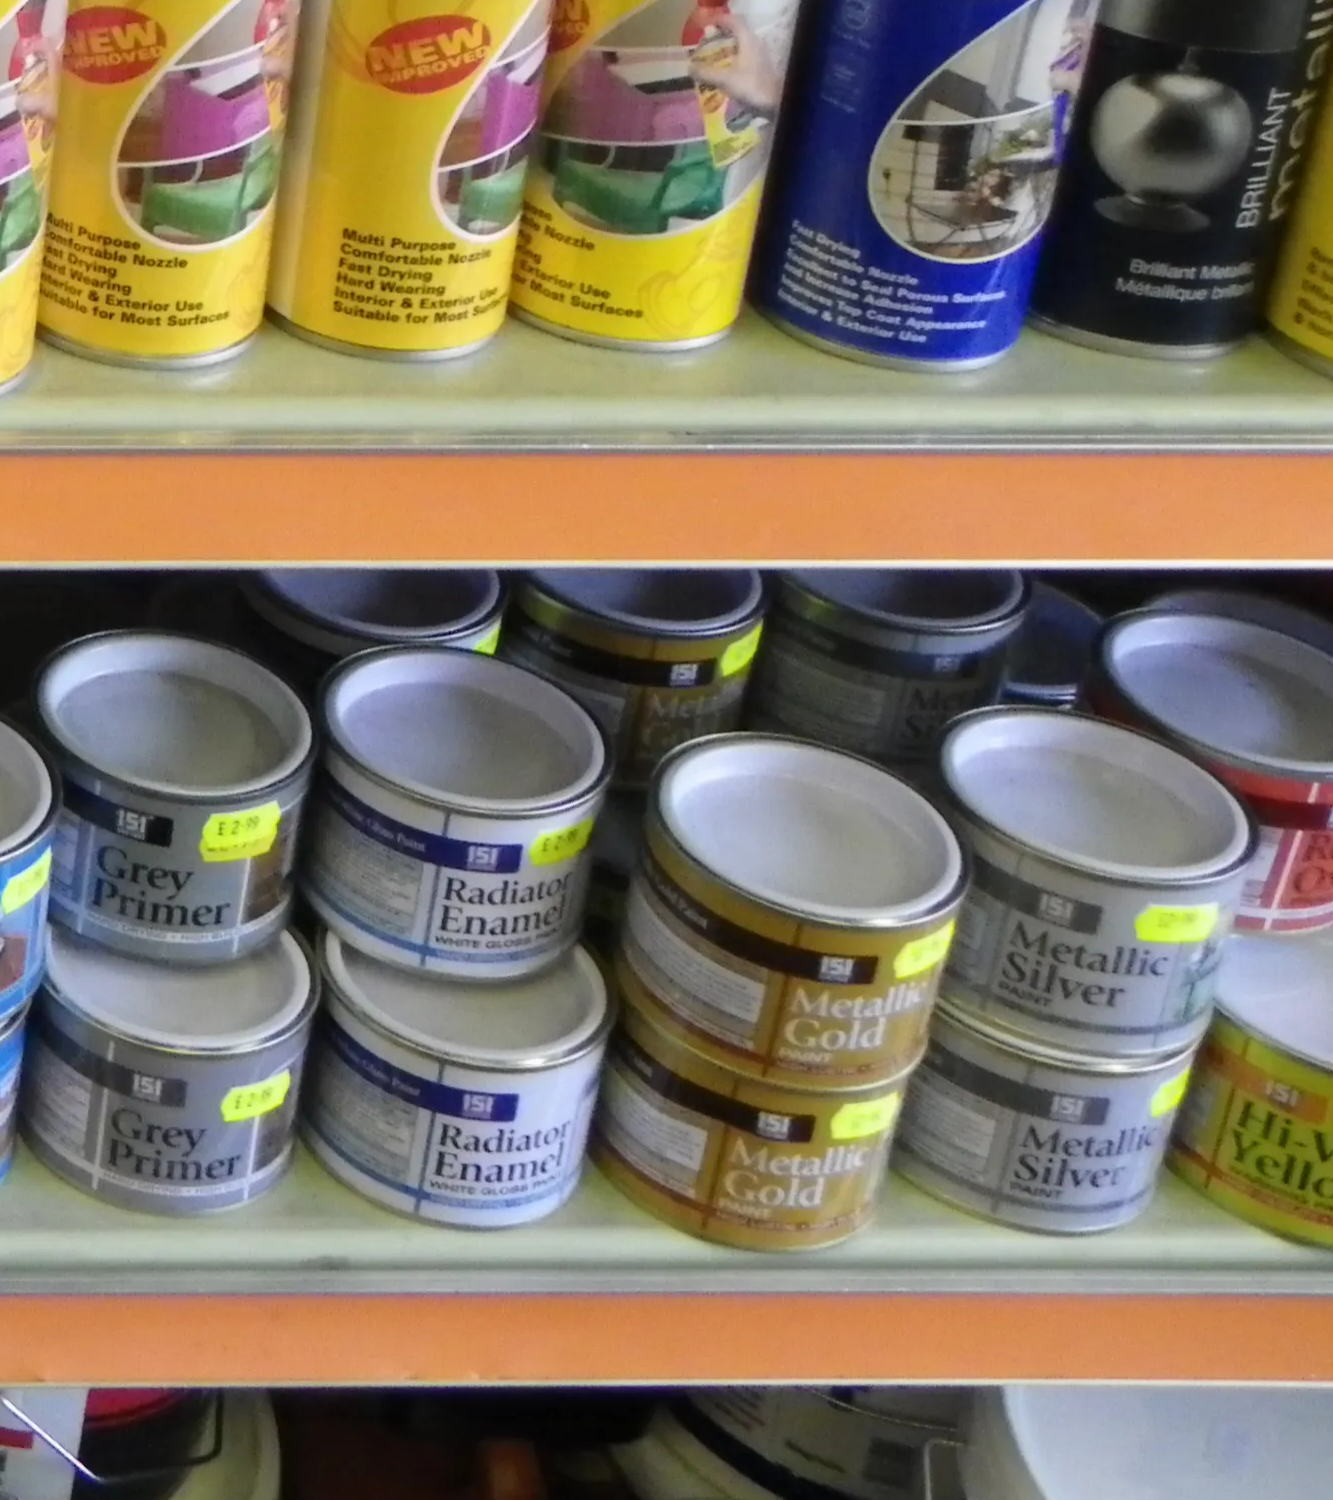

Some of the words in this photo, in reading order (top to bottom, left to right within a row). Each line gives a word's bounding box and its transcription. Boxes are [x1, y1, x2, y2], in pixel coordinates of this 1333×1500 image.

[97, 846, 193, 894] Grey
[92, 883, 231, 928] Primer
[442, 872, 573, 907] Radiator
[439, 900, 564, 937] Enamel
[1001, 952, 1125, 1008] Silver
[792, 983, 922, 1018] Metallic
[784, 1017, 885, 1050] Gold
[112, 1106, 206, 1154] Grey
[439, 1119, 570, 1154] Radiator
[106, 1140, 241, 1182] Primer
[434, 1147, 563, 1182] Enamel
[1014, 1154, 1125, 1189] Silver
[726, 1170, 824, 1208] Gold
